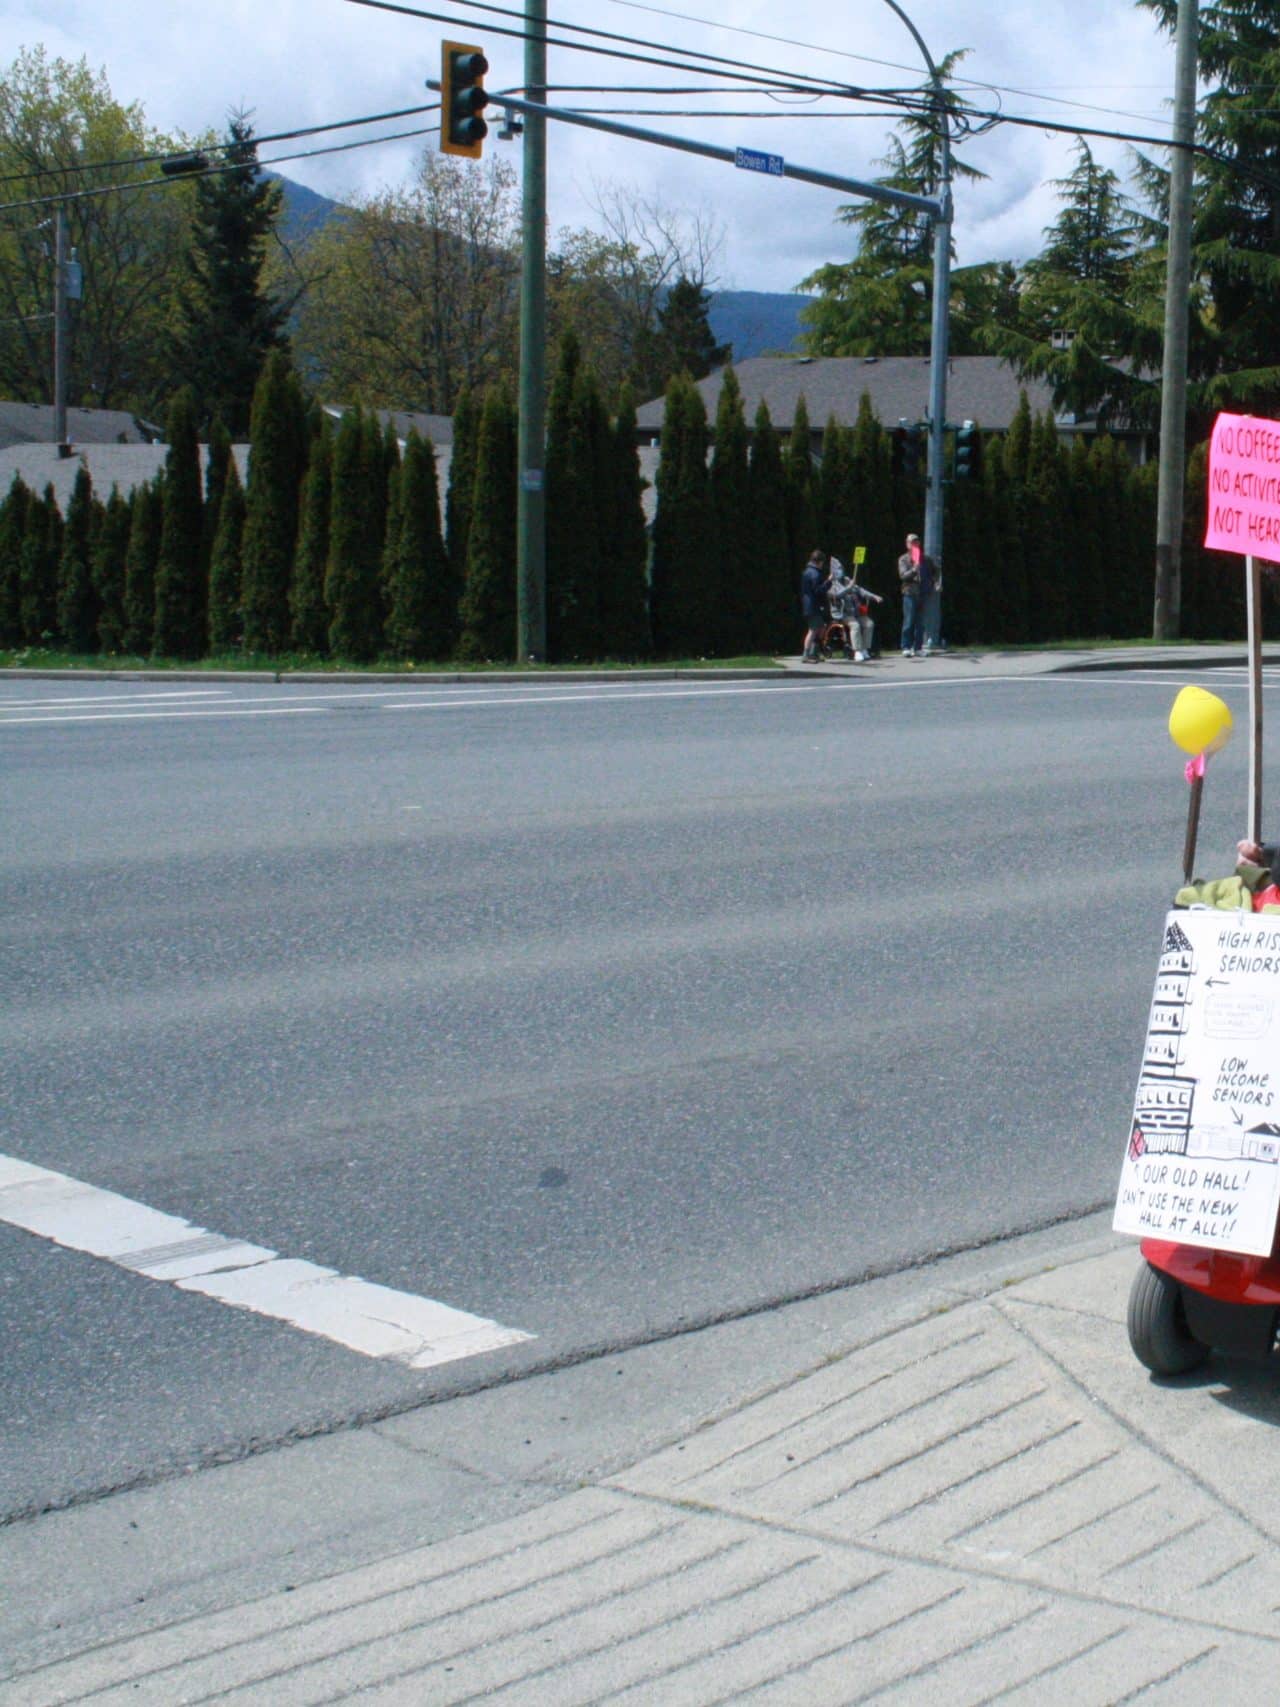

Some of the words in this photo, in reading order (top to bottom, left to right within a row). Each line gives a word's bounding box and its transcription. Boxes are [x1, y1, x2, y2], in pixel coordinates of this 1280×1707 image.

[737, 150, 766, 170] Bowen
[1216, 427, 1234, 455] NO
[1212, 467, 1231, 494] NO
[1213, 506, 1242, 536] NOT
[1218, 930, 1250, 949] HIGH
[1220, 1057, 1248, 1073] LOW
[1212, 1088, 1276, 1107] SENIORS
[1143, 1164, 1168, 1184] OUR
[1173, 1167, 1198, 1187] OLD
[1203, 1170, 1250, 1191] HALL!
[1122, 1188, 1144, 1204] CAN'T
[1148, 1192, 1168, 1210] USE
[1171, 1195, 1193, 1213] THE
[1199, 1199, 1239, 1216] NEW
[1139, 1211, 1162, 1228] HALL
[1169, 1216, 1187, 1231] AT
[1191, 1218, 1237, 1238] ALL!!
